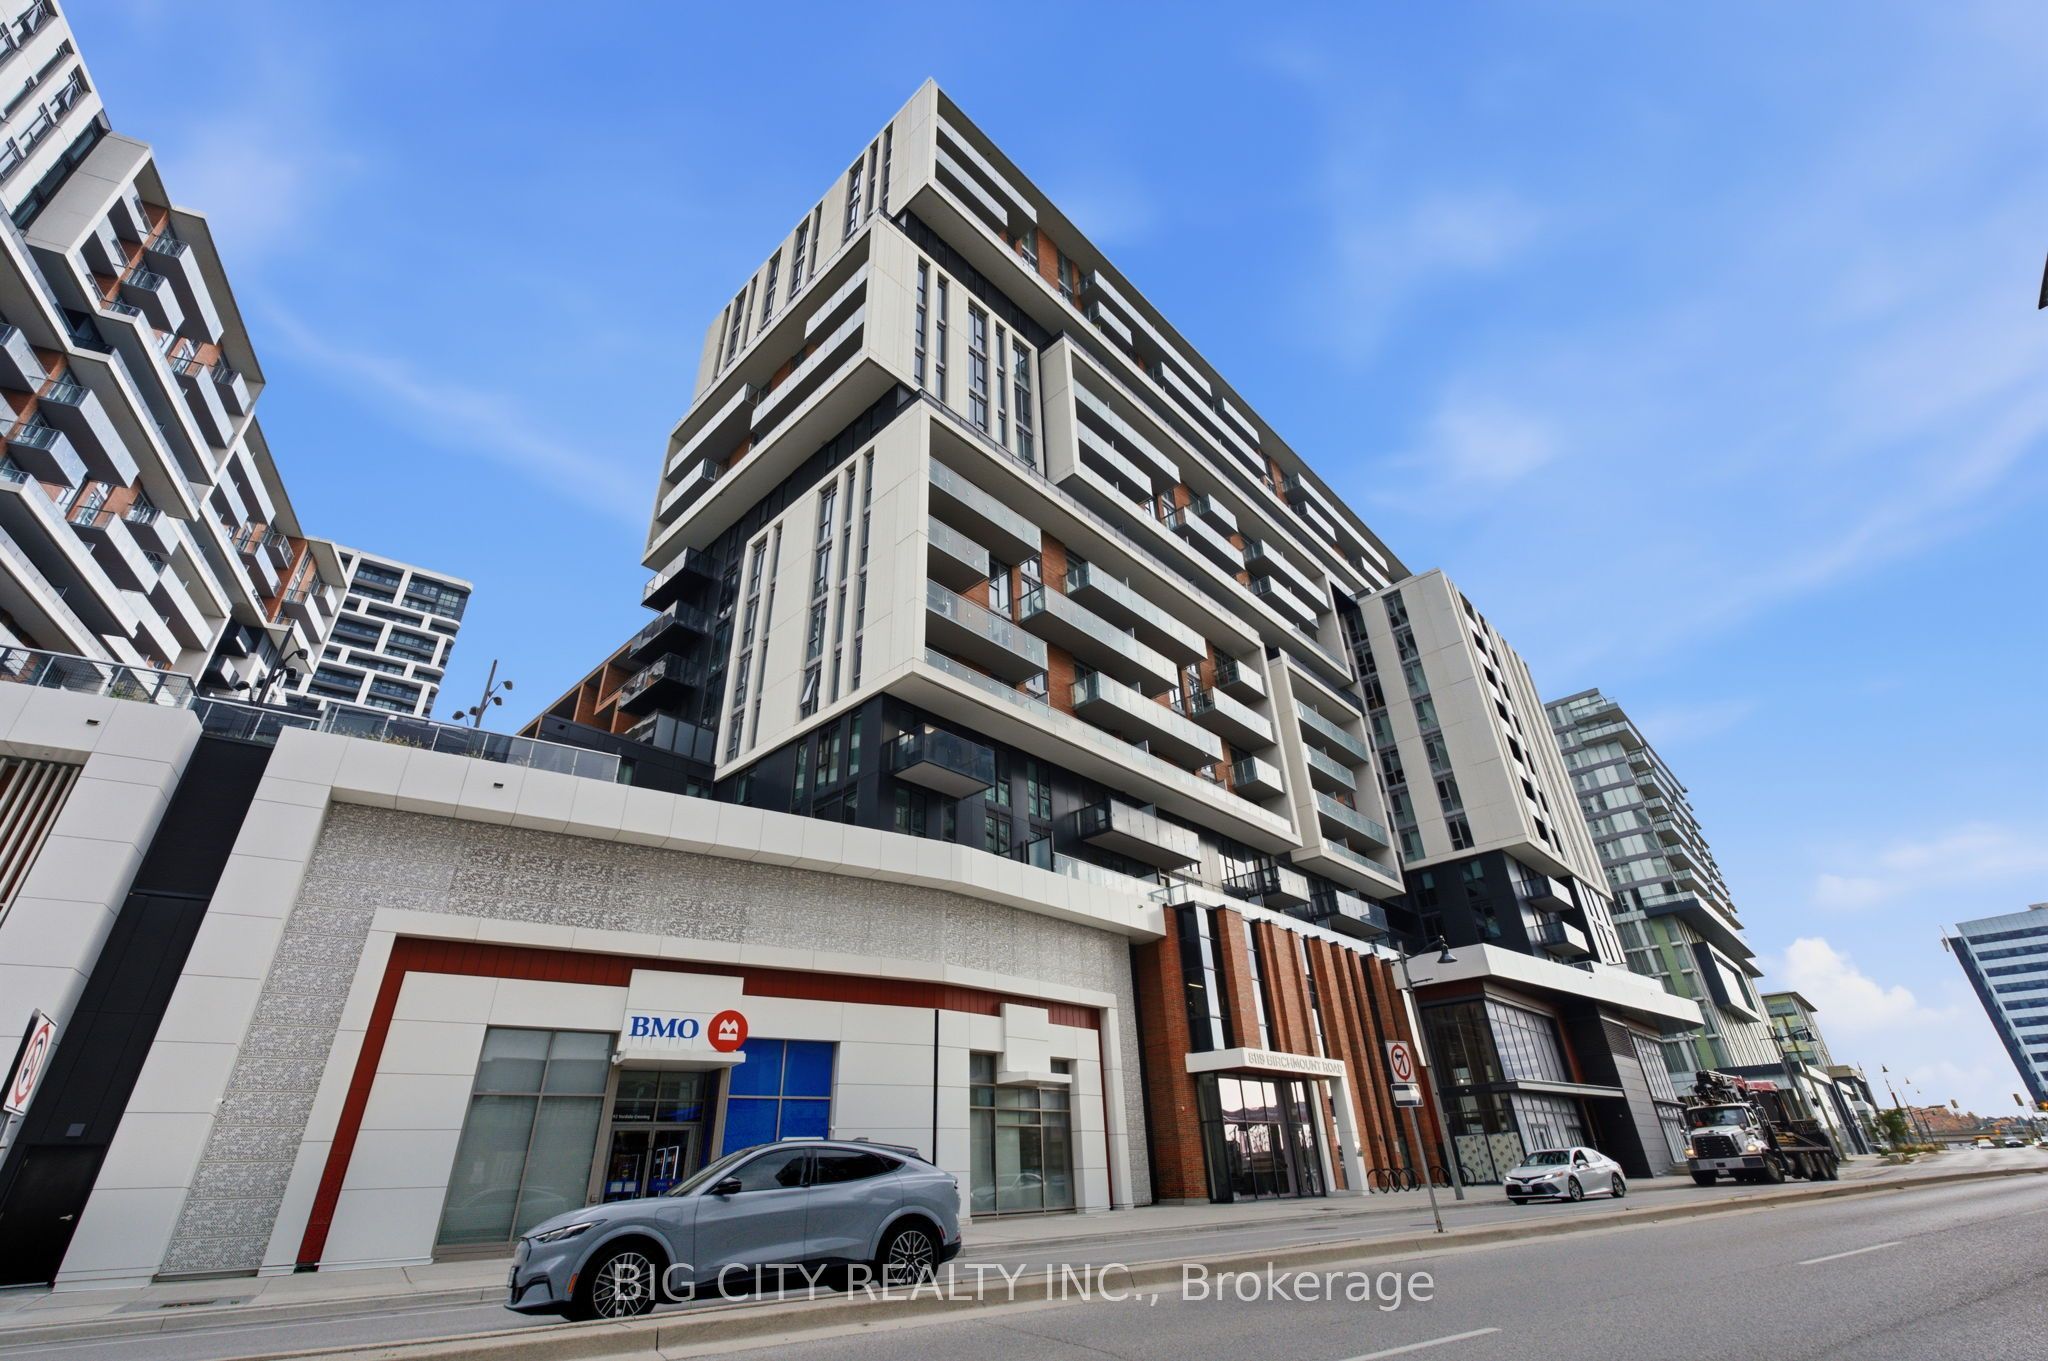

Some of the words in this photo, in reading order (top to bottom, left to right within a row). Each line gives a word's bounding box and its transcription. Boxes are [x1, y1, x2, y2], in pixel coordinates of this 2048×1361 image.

[628, 1016, 699, 1039] BMO
[1266, 1055, 1321, 1072] BIRCHMOUNT
[1321, 1061, 1343, 1074] ROAD
